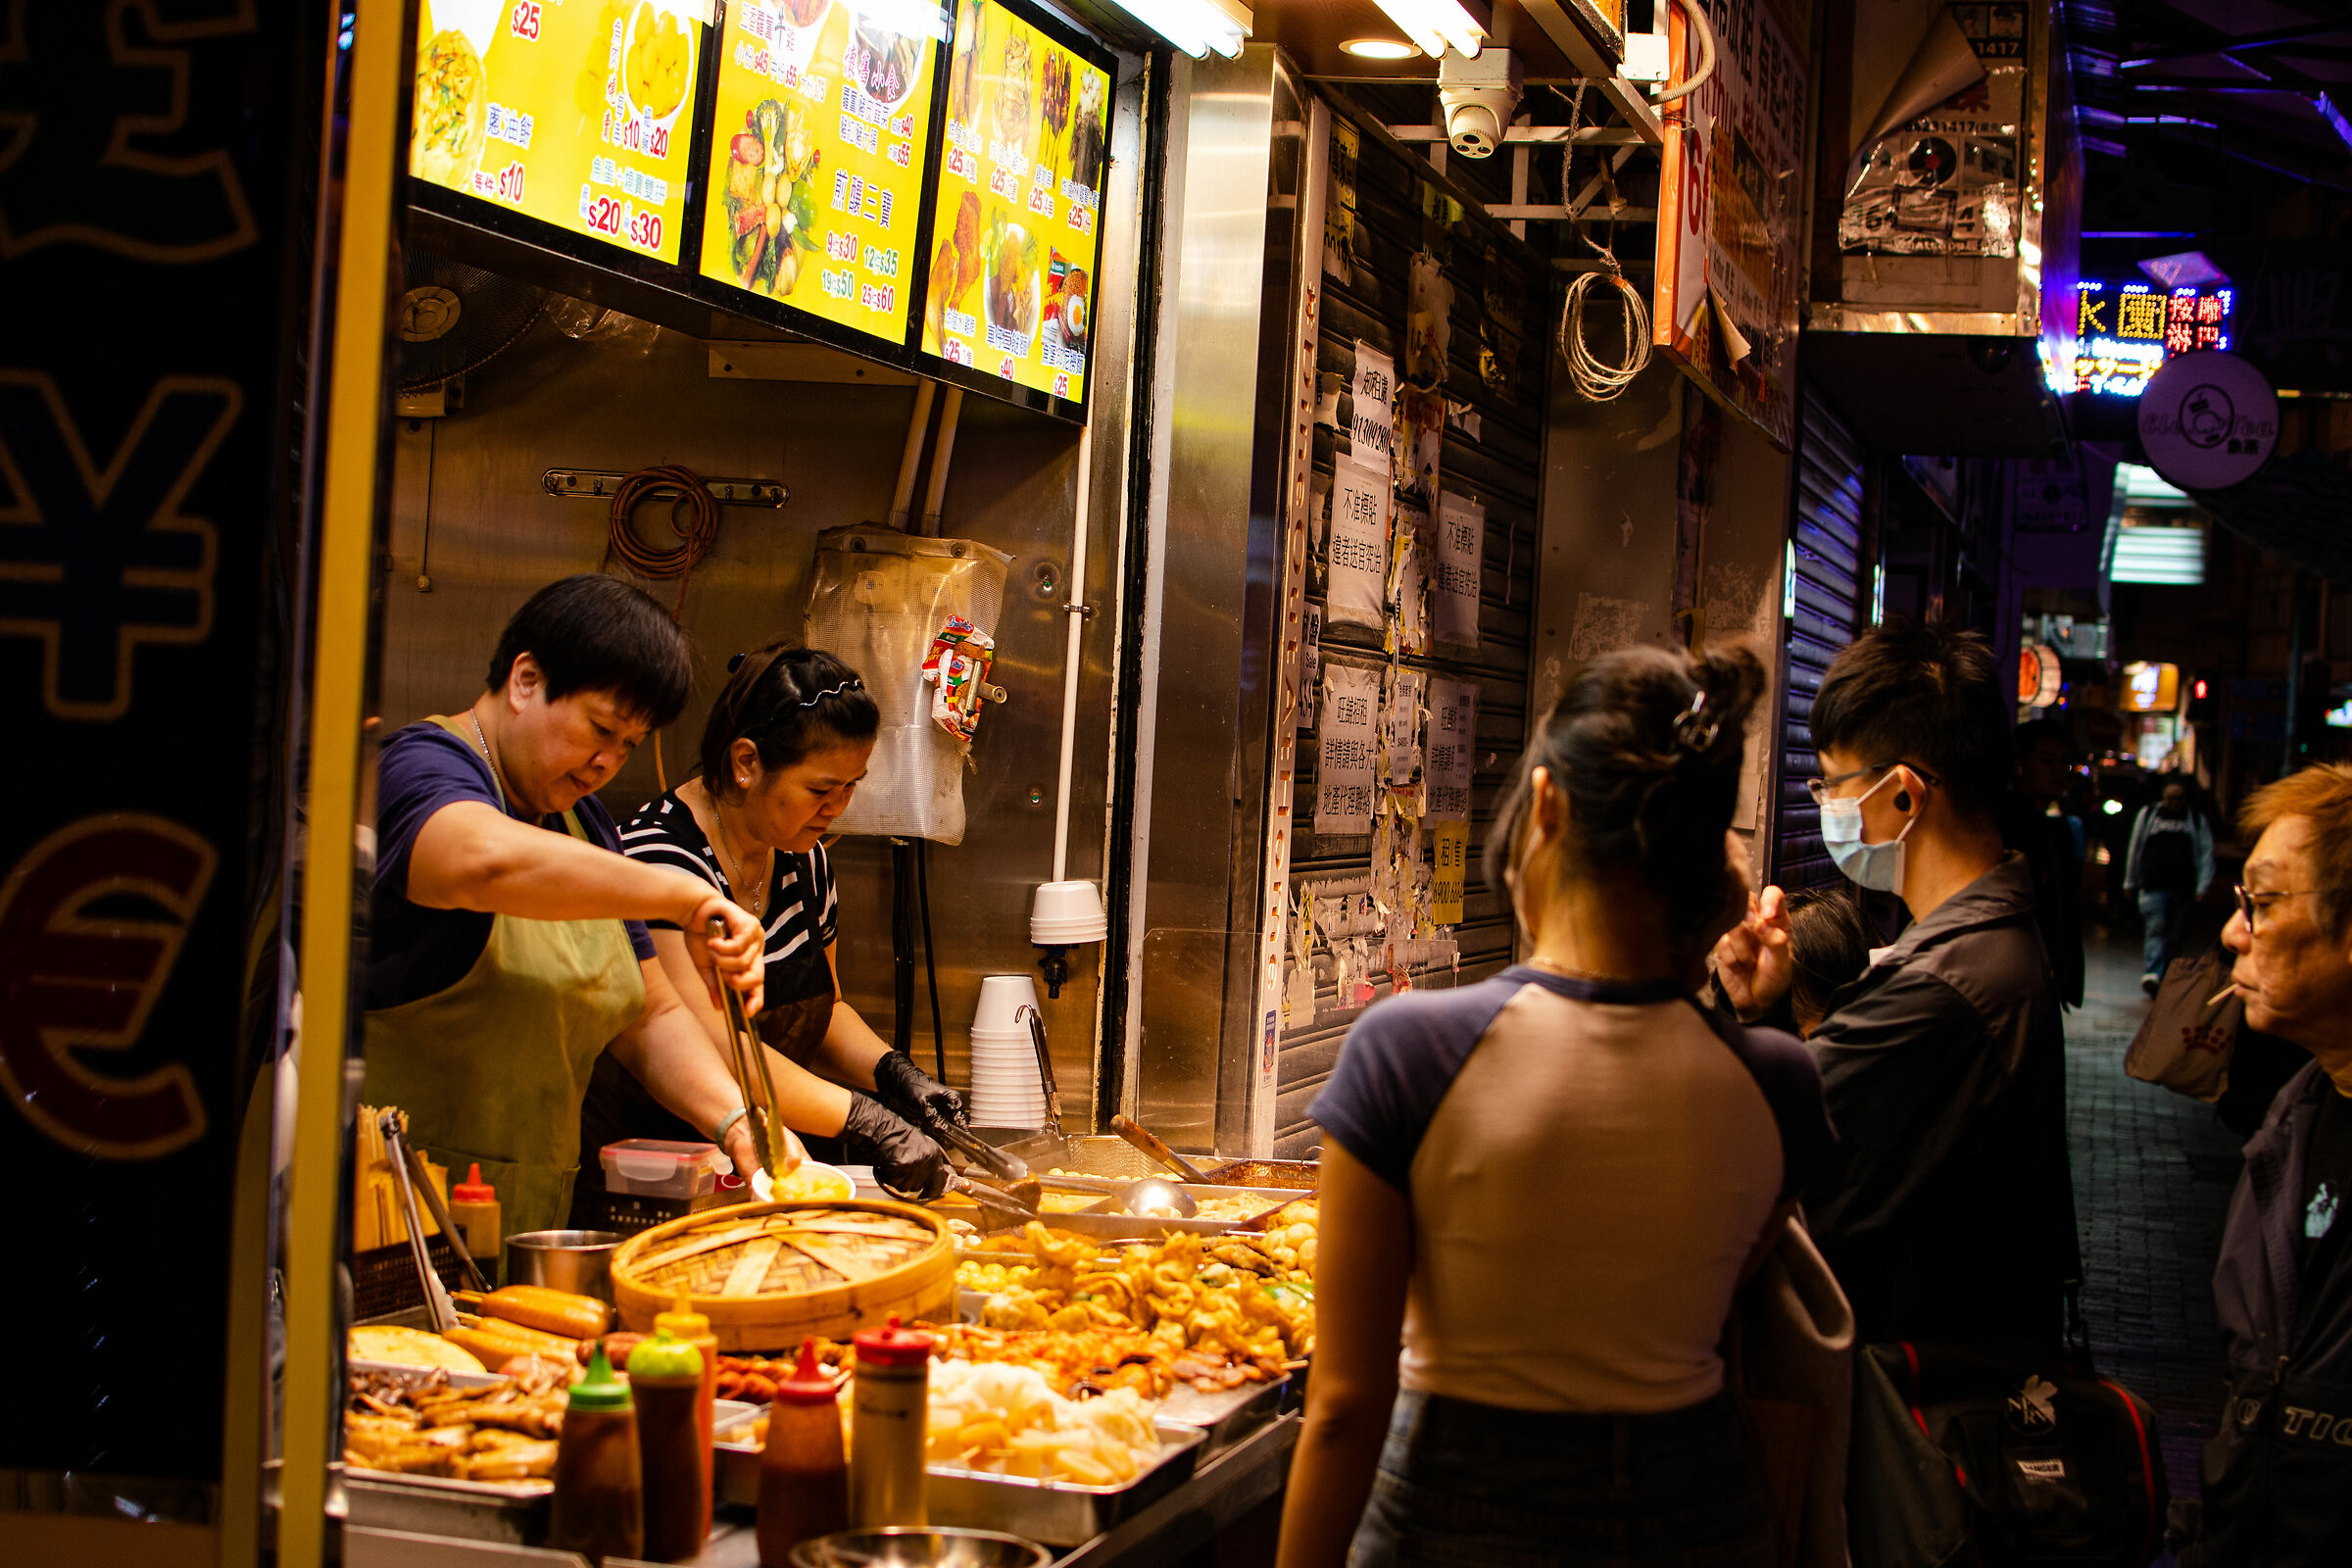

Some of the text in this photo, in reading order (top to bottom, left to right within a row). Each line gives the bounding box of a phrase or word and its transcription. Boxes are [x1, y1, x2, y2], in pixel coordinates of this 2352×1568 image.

[513, 1, 540, 39] $25
[755, 53, 768, 75] $45
[785, 66, 798, 86] $55
[623, 121, 640, 149] $10
[651, 128, 667, 158] $20
[902, 115, 913, 137] $40
[899, 144, 911, 167] $55
[948, 150, 964, 174] $25
[500, 164, 523, 201] $10
[991, 174, 1004, 195] $25
[832, 170, 894, 227] 煎釀三寶
[1028, 186, 1042, 211] $25
[588, 198, 620, 234] $20
[631, 213, 662, 248] $30
[1068, 206, 1083, 229] $25
[840, 234, 858, 262] $30
[880, 249, 899, 276] $35
[837, 272, 855, 298] $50
[877, 286, 894, 313] $60
[946, 339, 961, 364] $25
[1000, 358, 1014, 380] $40
[1054, 375, 1068, 398] $25
[1332, 534, 1382, 575] 違者送官究治
[1323, 786, 1372, 817] 地產代理聯絡
[1433, 881, 1449, 904] 6900
